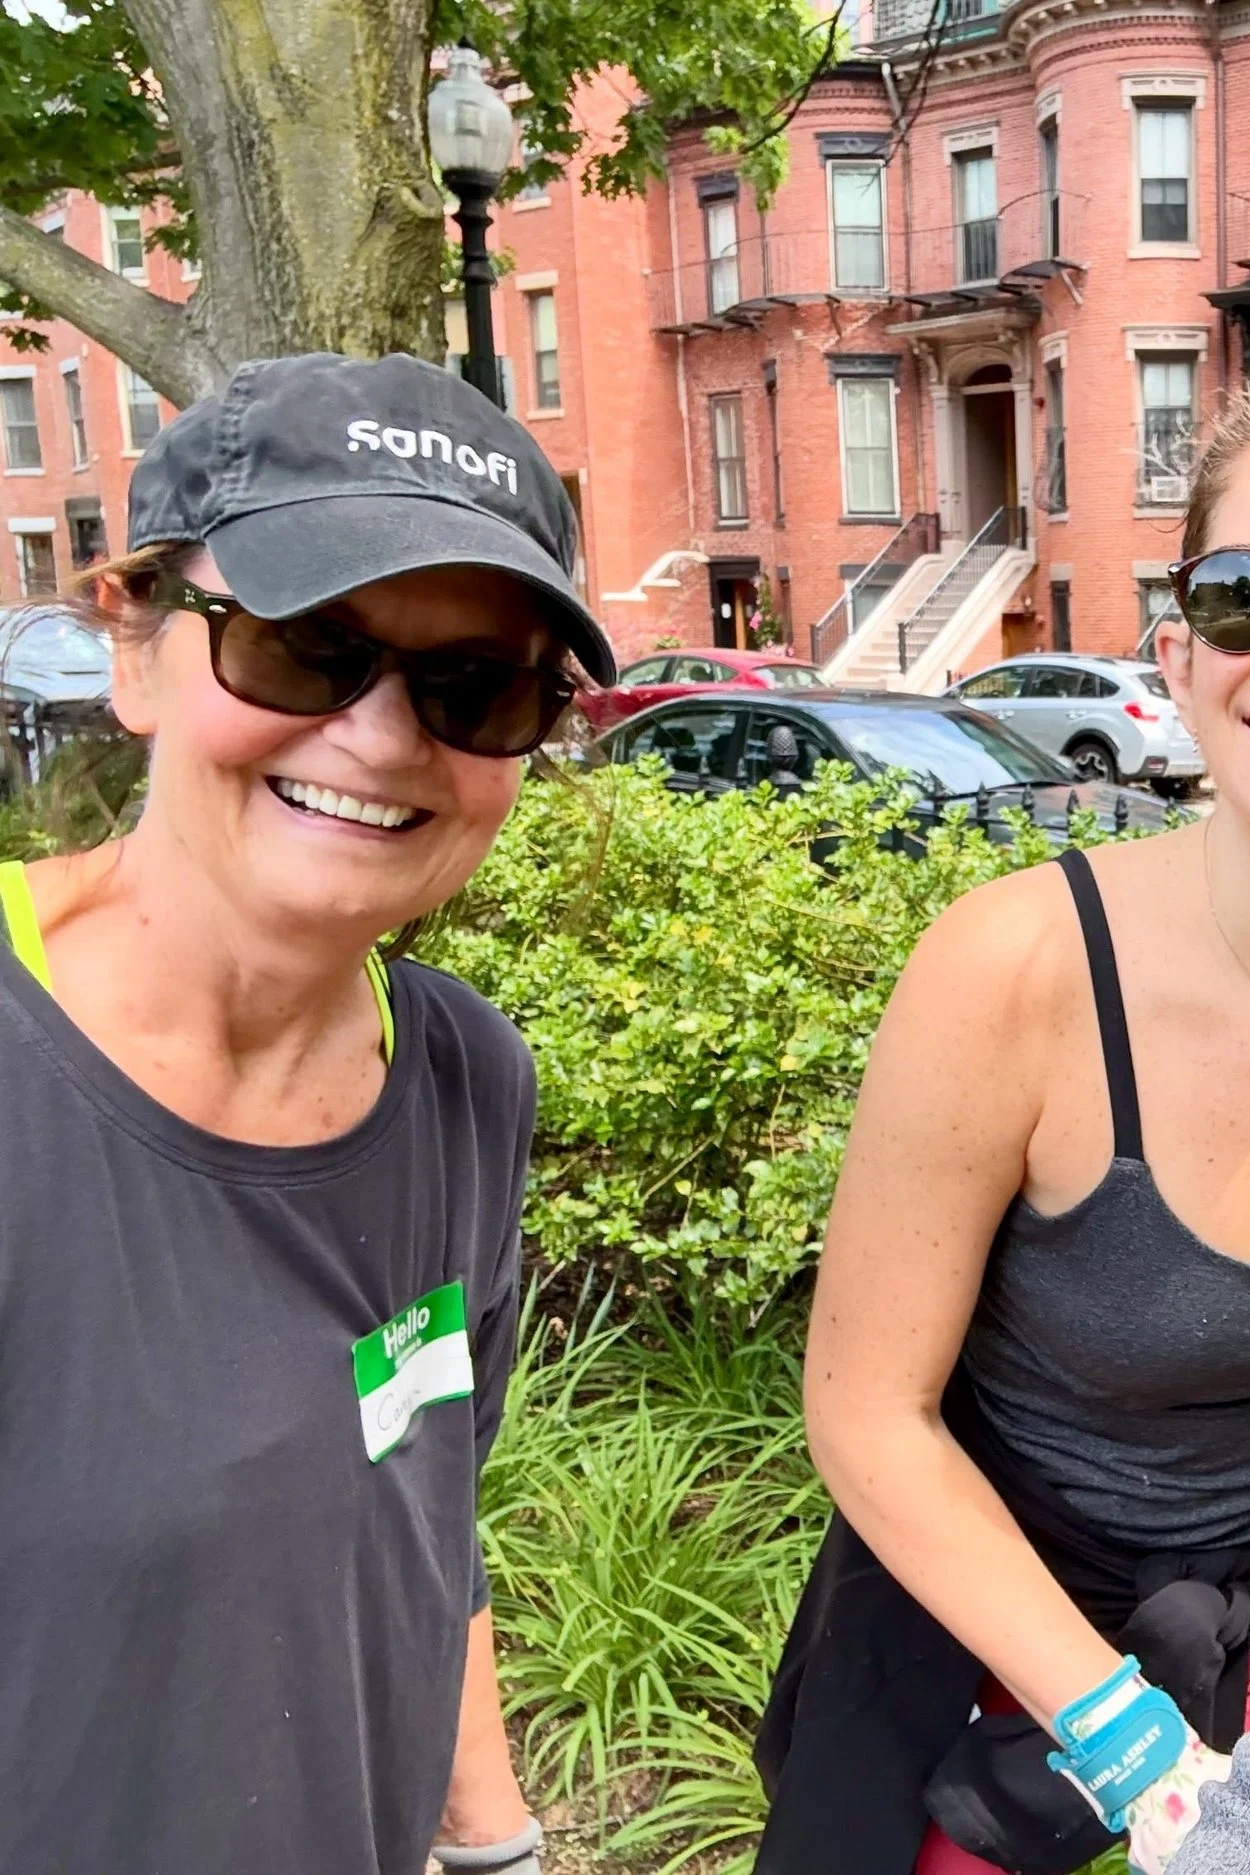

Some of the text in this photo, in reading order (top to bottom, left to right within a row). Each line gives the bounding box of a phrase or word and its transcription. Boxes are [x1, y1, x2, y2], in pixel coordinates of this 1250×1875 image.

[346, 419, 519, 497] sanofi
[382, 1305, 431, 1360] Hello
[1087, 1763, 1122, 1792] LAURA
[1121, 1723, 1162, 1769] ASHLEY
